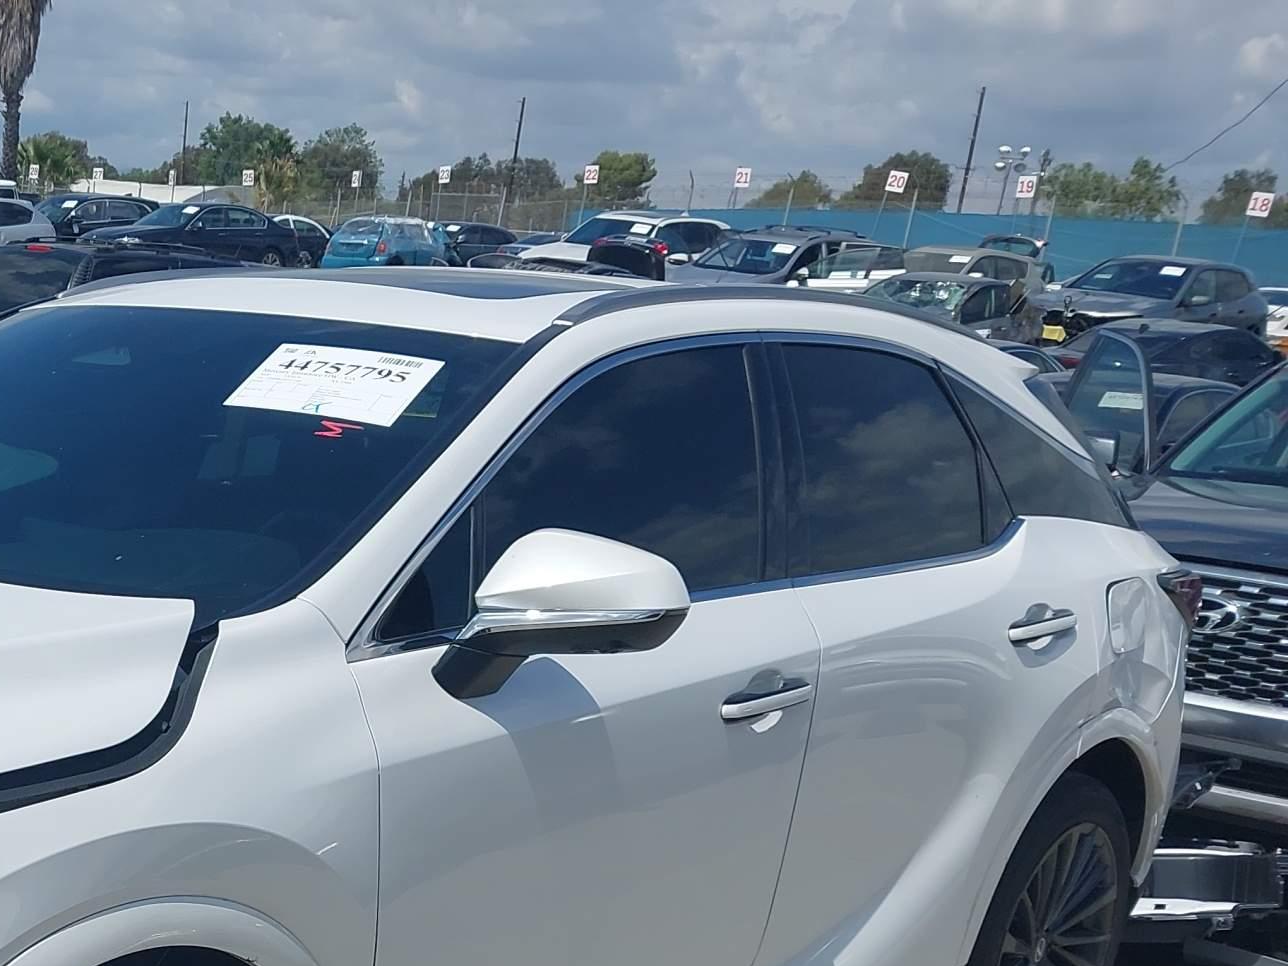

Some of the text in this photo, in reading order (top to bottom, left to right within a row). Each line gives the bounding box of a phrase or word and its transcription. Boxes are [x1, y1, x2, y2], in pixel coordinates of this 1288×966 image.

[94, 171, 103, 179] 27
[244, 173, 253, 183] 25
[440, 169, 451, 180] 23
[585, 169, 598, 181] 22
[736, 172, 749, 184] 21
[888, 175, 906, 189] 20
[1018, 180, 1034, 194] 19
[1250, 197, 1270, 212] 18
[279, 358, 412, 384] 44757795
